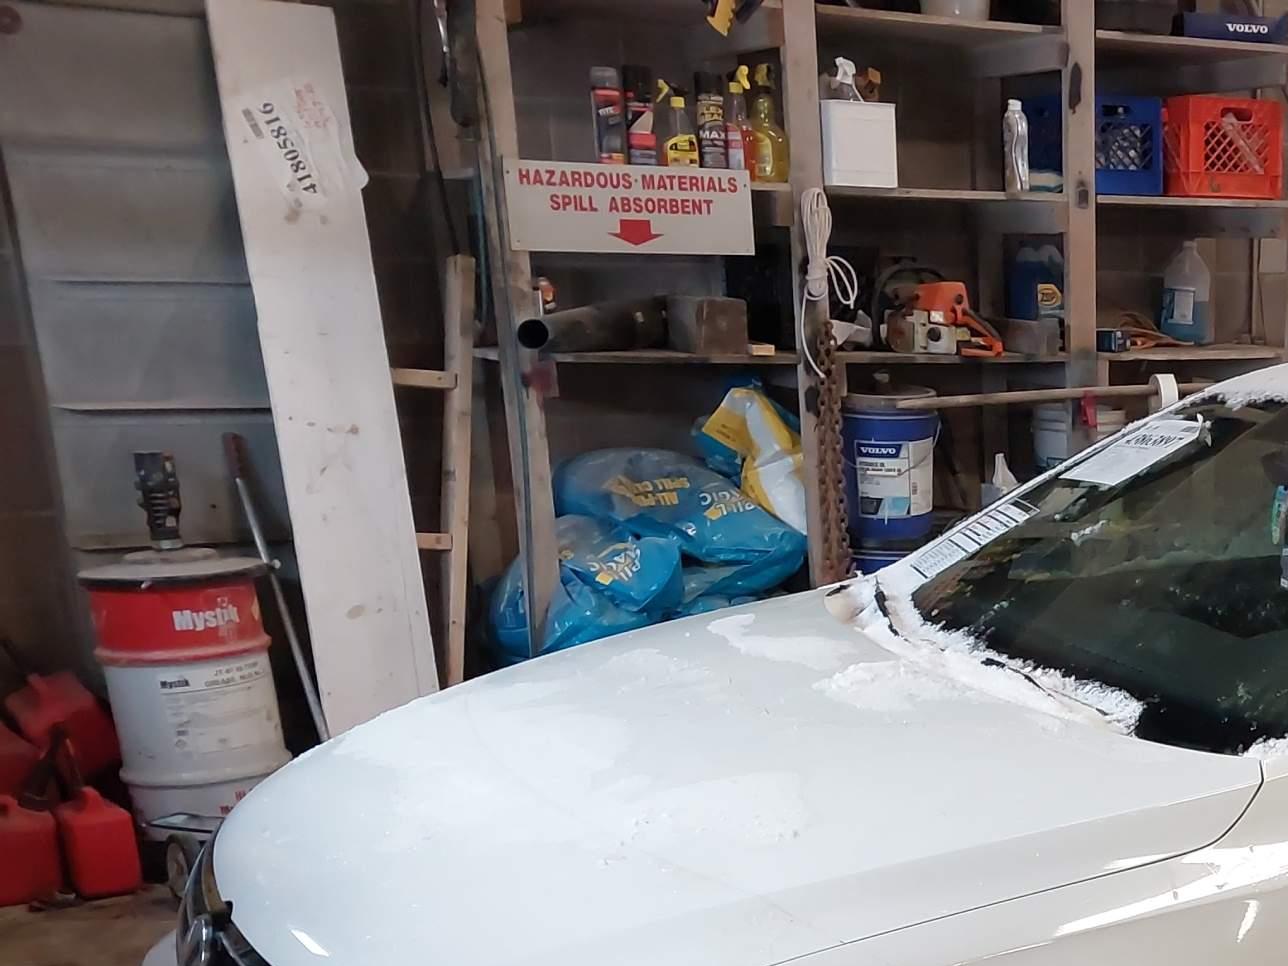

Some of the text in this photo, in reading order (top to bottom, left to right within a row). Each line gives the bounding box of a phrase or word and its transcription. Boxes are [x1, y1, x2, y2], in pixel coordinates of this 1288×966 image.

[1226, 23, 1269, 34] VOLVO
[258, 101, 318, 194] 41805816
[518, 167, 738, 193] HAZARDOUS MATERIALS
[550, 194, 714, 215] SPILL ABSORBENT
[860, 446, 897, 454] VOLVO
